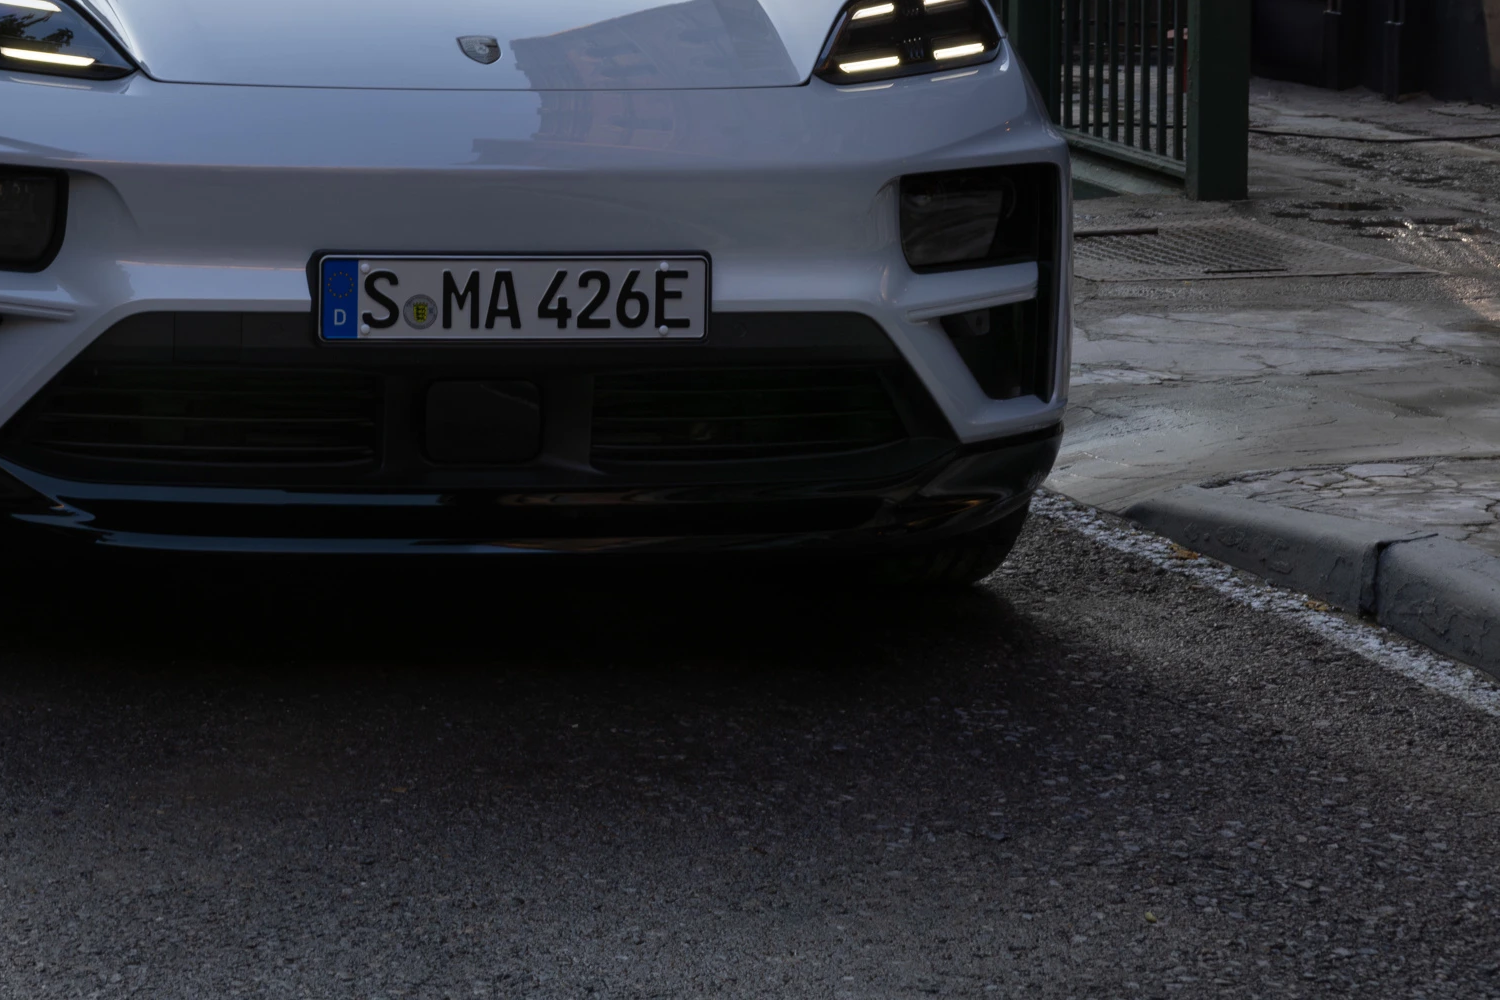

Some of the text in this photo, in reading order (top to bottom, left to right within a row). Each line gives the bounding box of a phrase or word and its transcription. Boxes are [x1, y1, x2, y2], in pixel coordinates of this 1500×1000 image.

[333, 308, 347, 326] D
[361, 270, 691, 329] S MA 426E
